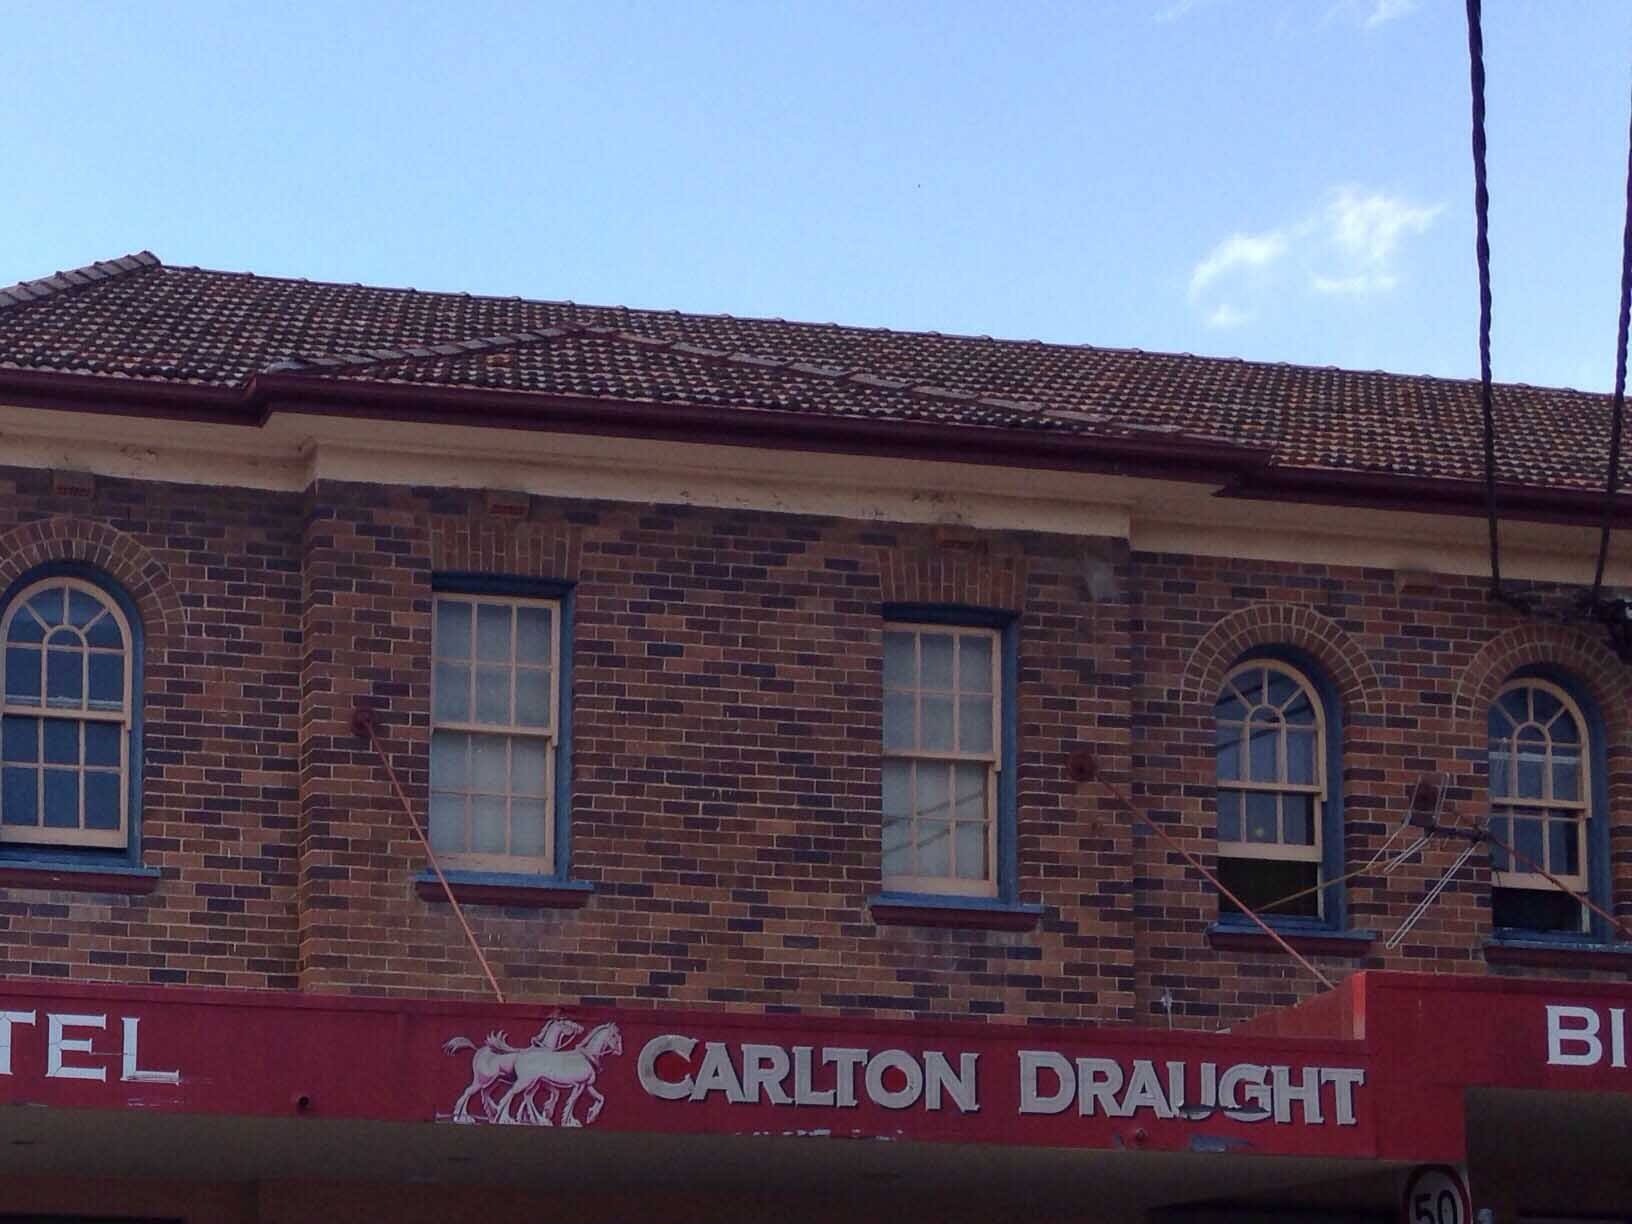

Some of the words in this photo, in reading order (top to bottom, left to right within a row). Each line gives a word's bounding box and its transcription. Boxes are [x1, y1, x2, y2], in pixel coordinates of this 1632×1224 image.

[1545, 1005, 1627, 1068] BI
[637, 1034, 980, 1113] CARLTON
[1017, 1049, 1366, 1125] DRAUGHT
